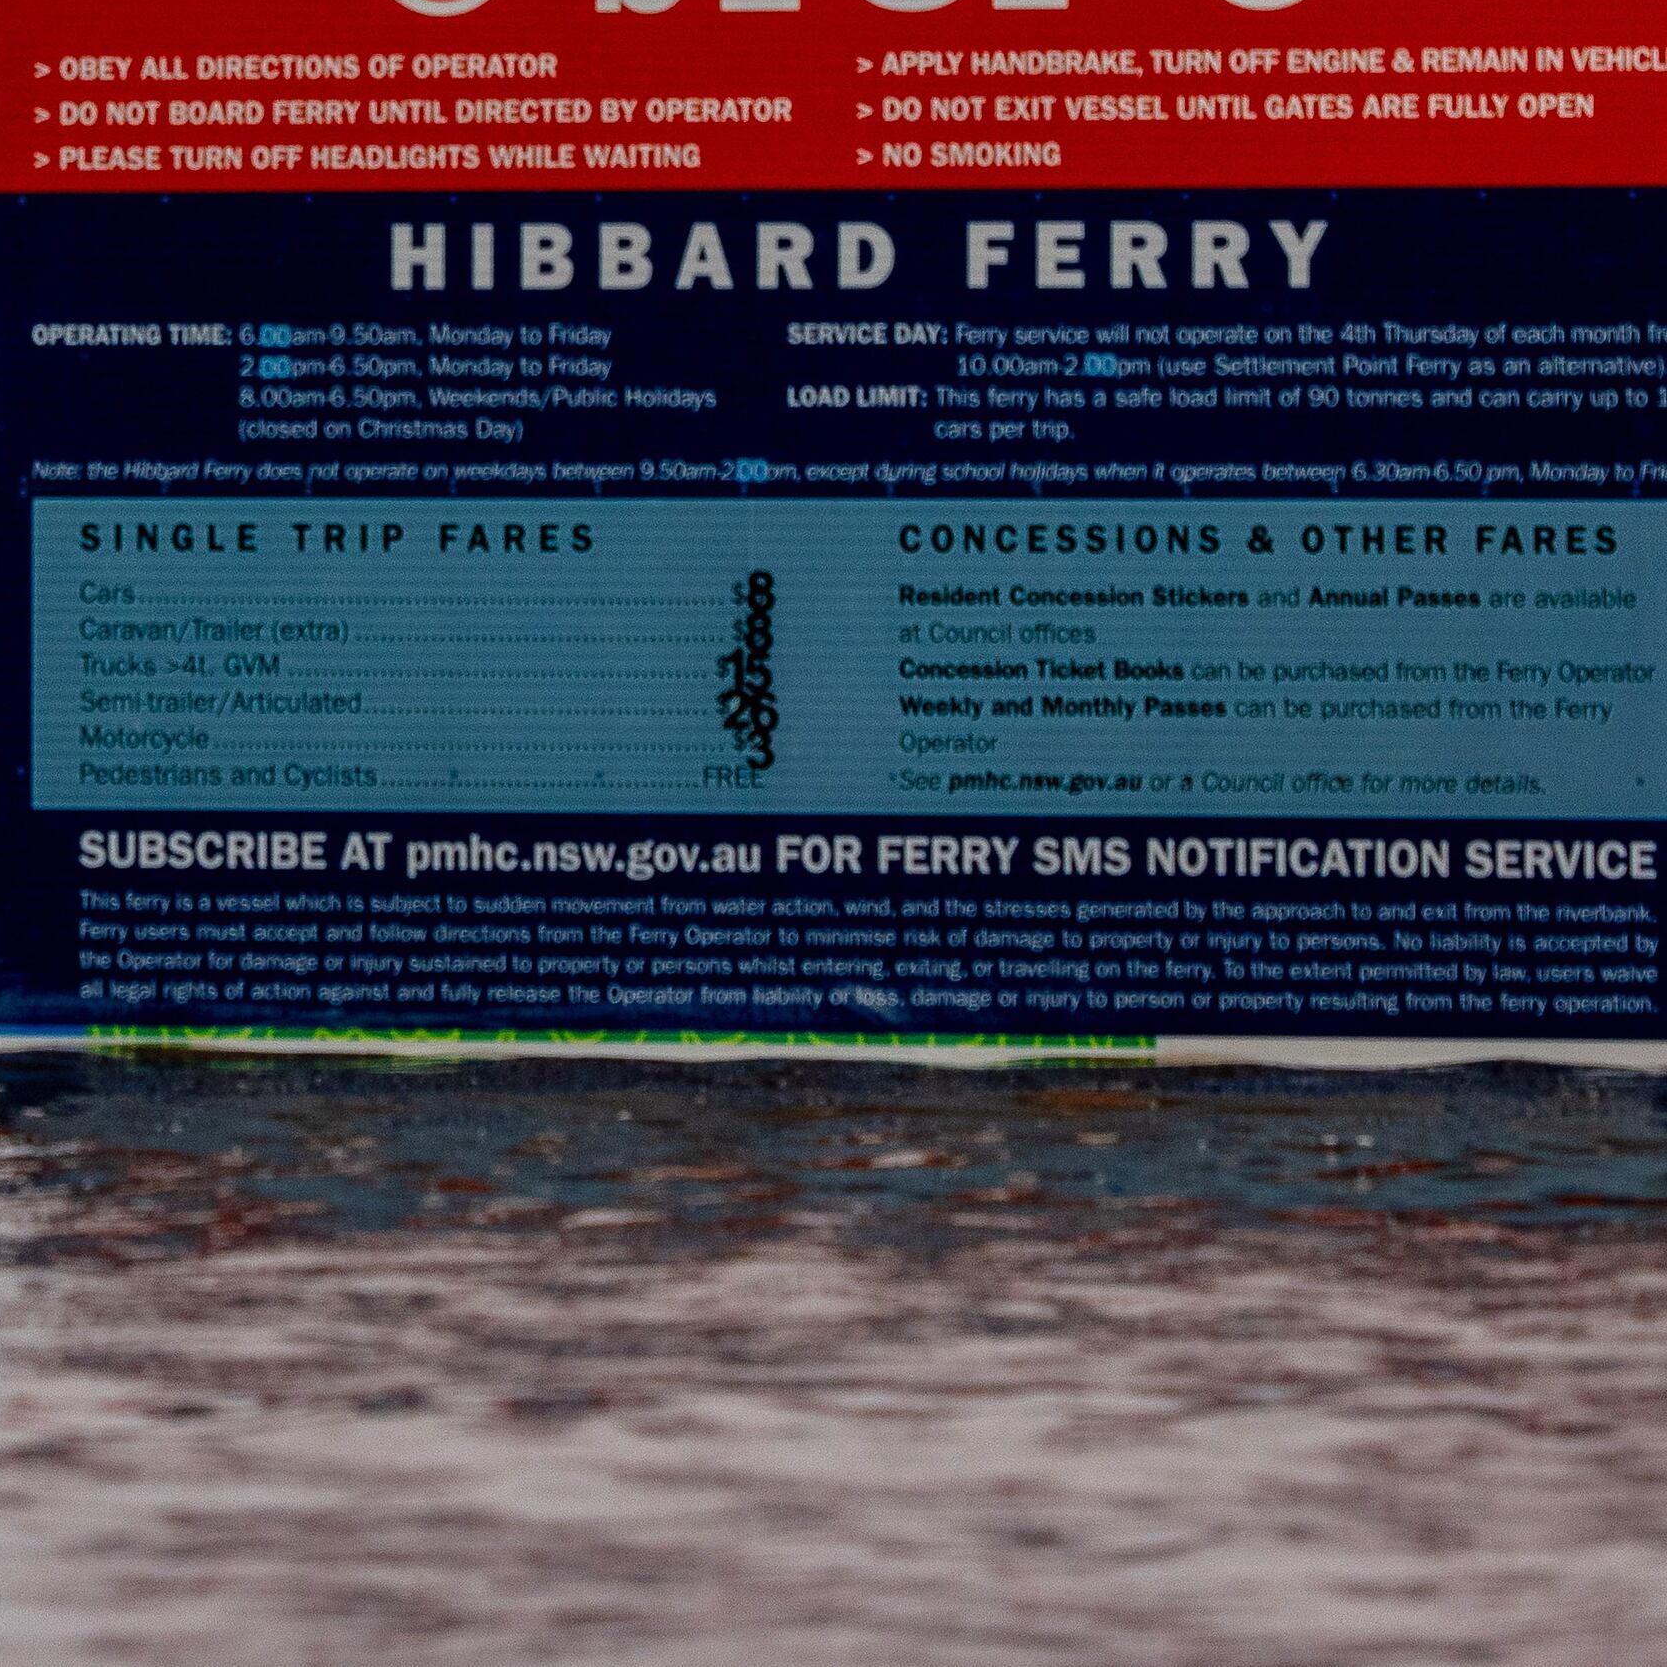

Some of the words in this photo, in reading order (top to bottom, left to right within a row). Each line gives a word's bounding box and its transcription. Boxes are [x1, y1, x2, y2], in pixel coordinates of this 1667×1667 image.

[59, 57, 132, 80] OBEY
[140, 57, 188, 79] ALL
[196, 55, 361, 79] DIRECTIONS
[368, 54, 404, 78] OF
[411, 54, 558, 78] OPERATOR
[882, 52, 962, 75] APPLY
[971, 51, 1143, 79] HANDBRAKE,
[1151, 50, 1222, 73] TURN
[1229, 50, 1279, 73] OFF
[1287, 49, 1385, 72] ENGINE
[1392, 49, 1414, 72] &
[1421, 48, 1528, 72] REMAIN
[1536, 48, 1564, 71] IN
[1571, 47, 1667, 71] VEHICL
[59, 102, 98, 125] DO
[106, 101, 160, 124] NOT
[168, 101, 265, 124] BOARD
[272, 100, 360, 124] FERRY
[368, 100, 447, 124] UNTIL
[455, 99, 593, 123] DIRECTED
[600, 99, 637, 122] BY
[645, 98, 793, 122] OPERATOR
[882, 97, 923, 121] DO
[930, 97, 986, 121] NOT
[994, 96, 1056, 120] EXIT
[1064, 96, 1169, 120] VESSEL
[1176, 95, 1257, 119] UNTIL
[1264, 95, 1354, 119] GATES
[1362, 94, 1420, 118] ARE
[1427, 94, 1509, 118] FULLY
[1517, 93, 1595, 117] OPEN
[58, 147, 162, 170] PLEASE
[169, 146, 243, 170] TURN
[250, 146, 303, 169] OFF
[310, 145, 481, 169] HEADLIGHTS
[488, 145, 576, 168] WHILE
[583, 144, 701, 167] WAITING
[882, 143, 922, 167] NO
[931, 142, 1061, 166] SMOKING
[390, 222, 896, 292] HIBBARD
[966, 218, 1333, 290] FERRY
[30, 324, 163, 346] OPERATING
[166, 324, 233, 346] TIME:
[428, 324, 514, 351] Monday
[518, 324, 544, 346] to
[547, 324, 613, 351] Friday
[786, 321, 888, 343] SERVICE
[893, 321, 949, 343] DAY:
[954, 321, 1008, 349] Ferry
[1013, 321, 1090, 343] service
[1095, 321, 1130, 343] will
[1134, 321, 1170, 343] not
[1175, 321, 1259, 349] operate
[1263, 327, 1293, 343] on
[1297, 321, 1334, 343] the
[1339, 321, 1377, 343] 4th
[1382, 321, 1479, 349] Thursday
[1484, 321, 1507, 343] of
[1511, 321, 1566, 343] each
[1570, 321, 1641, 343] month
[427, 355, 515, 382] Monday
[518, 355, 544, 377] to
[547, 355, 613, 382] Friday
[1156, 353, 1208, 380] (use
[1213, 353, 1337, 375] Settlement
[1341, 353, 1400, 375] Point
[1404, 353, 1463, 380] Ferry
[1466, 359, 1497, 375] as
[1501, 359, 1532, 375] an
[623, 386, 718, 413] Holidays
[784, 385, 852, 407] LOAD
[854, 385, 930, 407] LIMIT:
[933, 385, 983, 407] This
[985, 385, 1040, 412] ferry
[1042, 385, 1088, 407] has
[1090, 391, 1109, 407] a
[1112, 385, 1164, 407] safe
[1167, 385, 1219, 407] load
[1222, 385, 1273, 407] limit
[1276, 385, 1304, 407] of
[1305, 385, 1342, 407] 90
[1343, 385, 1425, 407] tonnes
[1428, 385, 1474, 407] and
[1476, 391, 1522, 407] can
[1524, 391, 1585, 412] carry
[1587, 391, 1621, 412] up
[1623, 385, 1651, 407] to
[238, 416, 318, 443] (closed
[323, 421, 352, 438] on
[357, 416, 469, 438] Christmas
[475, 416, 524, 443] Day)
[934, 422, 982, 439] cars
[989, 422, 1025, 444] per
[78, 523, 260, 553] SINGLE
[292, 523, 407, 553] TRIP
[439, 523, 596, 554] FARES
[898, 524, 1223, 555] CONCESSIONS
[1246, 525, 1276, 555] &
[1300, 525, 1449, 556] OTHER
[1476, 525, 1620, 556] FARES
[78, 581, 137, 604] Cars
[897, 585, 1002, 607] Resident
[1008, 585, 1145, 607] Concession
[1151, 585, 1250, 607] Stickers
[1257, 585, 1301, 607] and
[1307, 585, 1390, 607] Annual
[1396, 586, 1482, 608] Passes
[1488, 591, 1526, 608] are
[1534, 586, 1637, 608] available
[78, 617, 265, 640] Caravan/Trailer
[898, 623, 921, 645] at
[928, 623, 1012, 645] Council
[81, 652, 156, 675] Trucks
[223, 653, 280, 676] GVM
[78, 727, 210, 755] Motorcycle
[78, 762, 223, 785] Pedestrians
[230, 763, 276, 786] and
[283, 763, 378, 791] Cyclists
[77, 832, 329, 869] SUBSCRIBE
[339, 833, 394, 870] AT
[405, 835, 763, 880] pmhc.nsw.gov.au
[775, 836, 864, 873] FOR
[876, 837, 1021, 874] FERRY
[1031, 838, 1133, 875] SMS
[1145, 839, 1451, 877] NOTIFICATION
[1464, 841, 1659, 878] SERVICE
